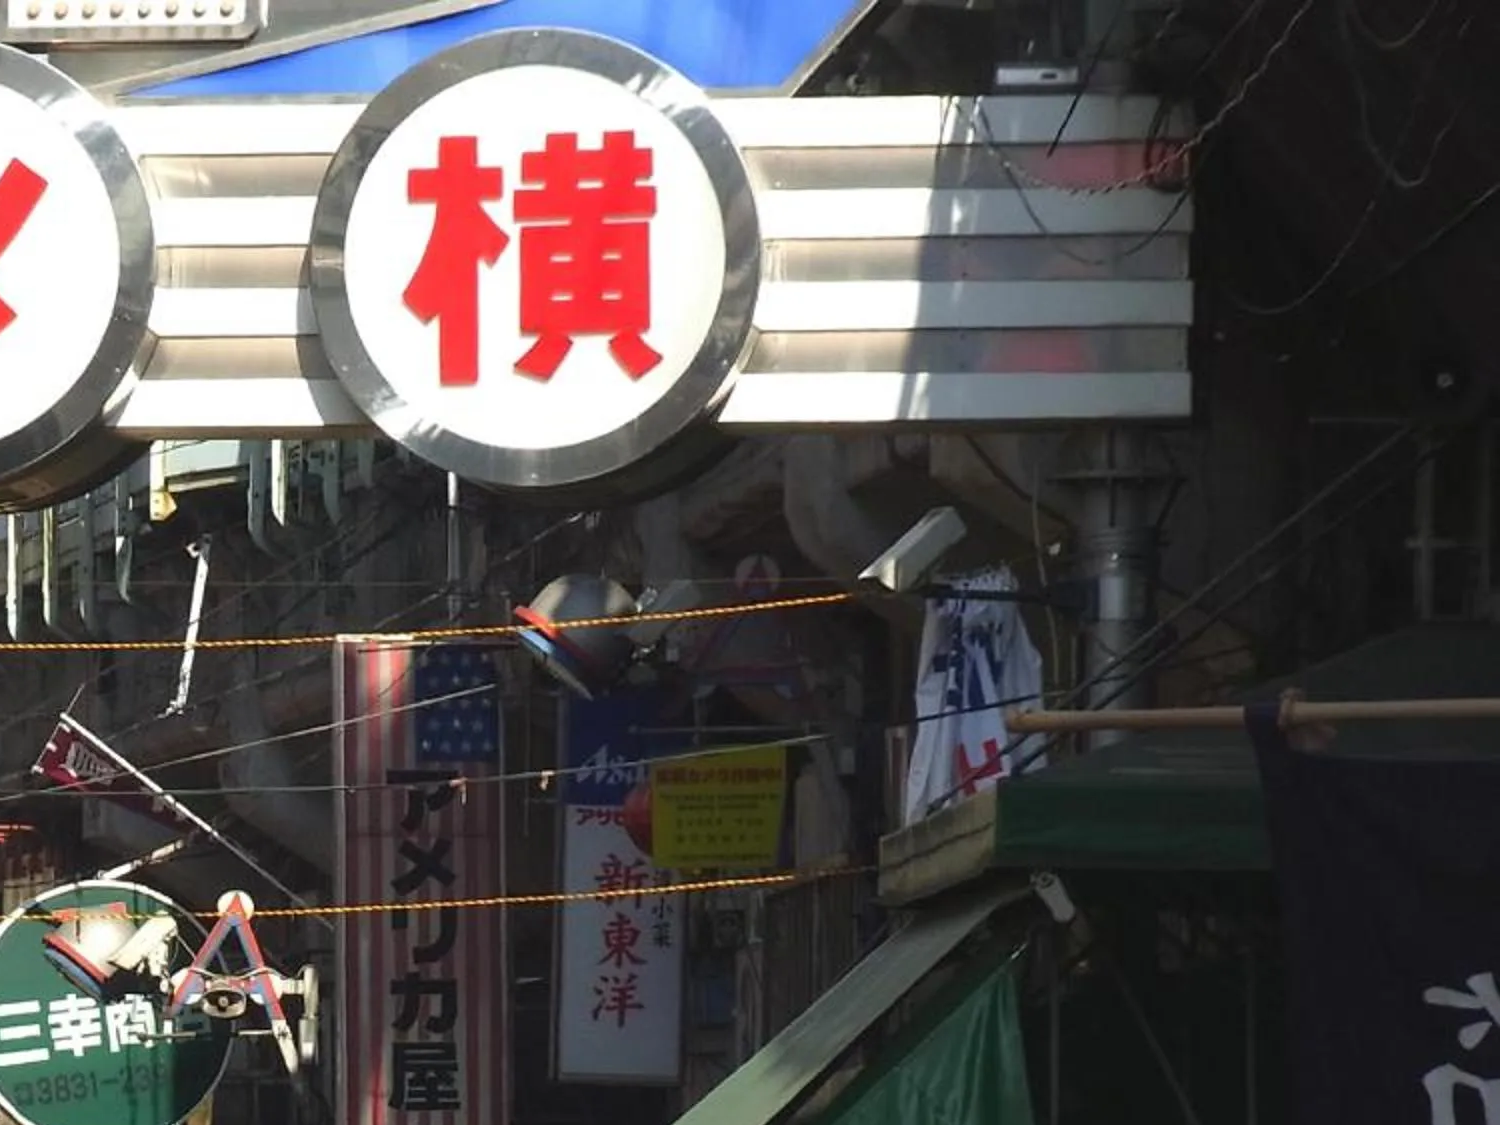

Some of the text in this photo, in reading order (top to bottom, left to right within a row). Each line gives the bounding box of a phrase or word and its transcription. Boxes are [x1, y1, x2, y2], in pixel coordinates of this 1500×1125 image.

[386, 770, 460, 1112] アメリカ屋
[592, 852, 649, 1029] 新東洋
